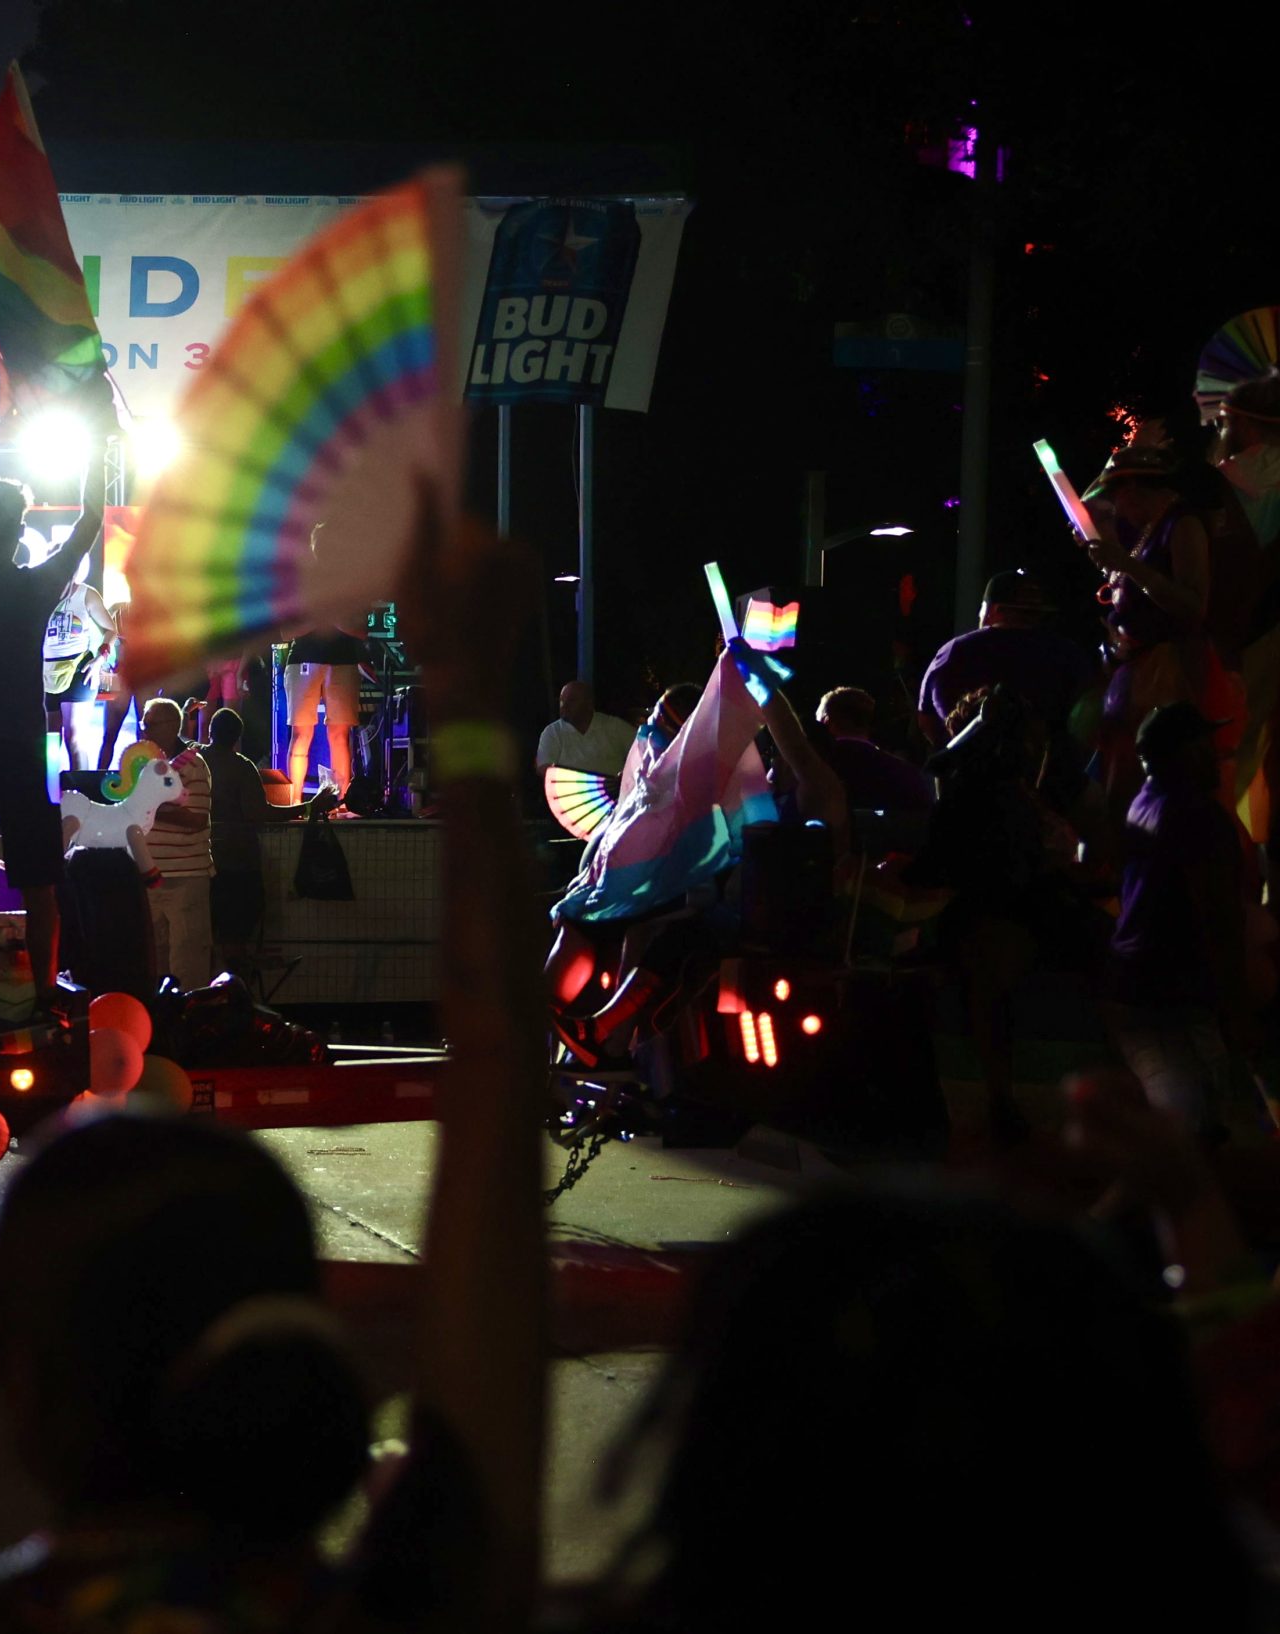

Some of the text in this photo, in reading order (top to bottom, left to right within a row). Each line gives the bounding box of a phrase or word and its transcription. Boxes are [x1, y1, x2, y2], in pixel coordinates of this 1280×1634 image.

[66, 195, 91, 203] LIGHT
[120, 196, 164, 204] BUD LIGHT
[192, 196, 236, 204] BUD LIGHT
[265, 197, 309, 205] BUD LIGHT
[492, 295, 608, 340] BUD
[470, 339, 613, 384] LIGHT
